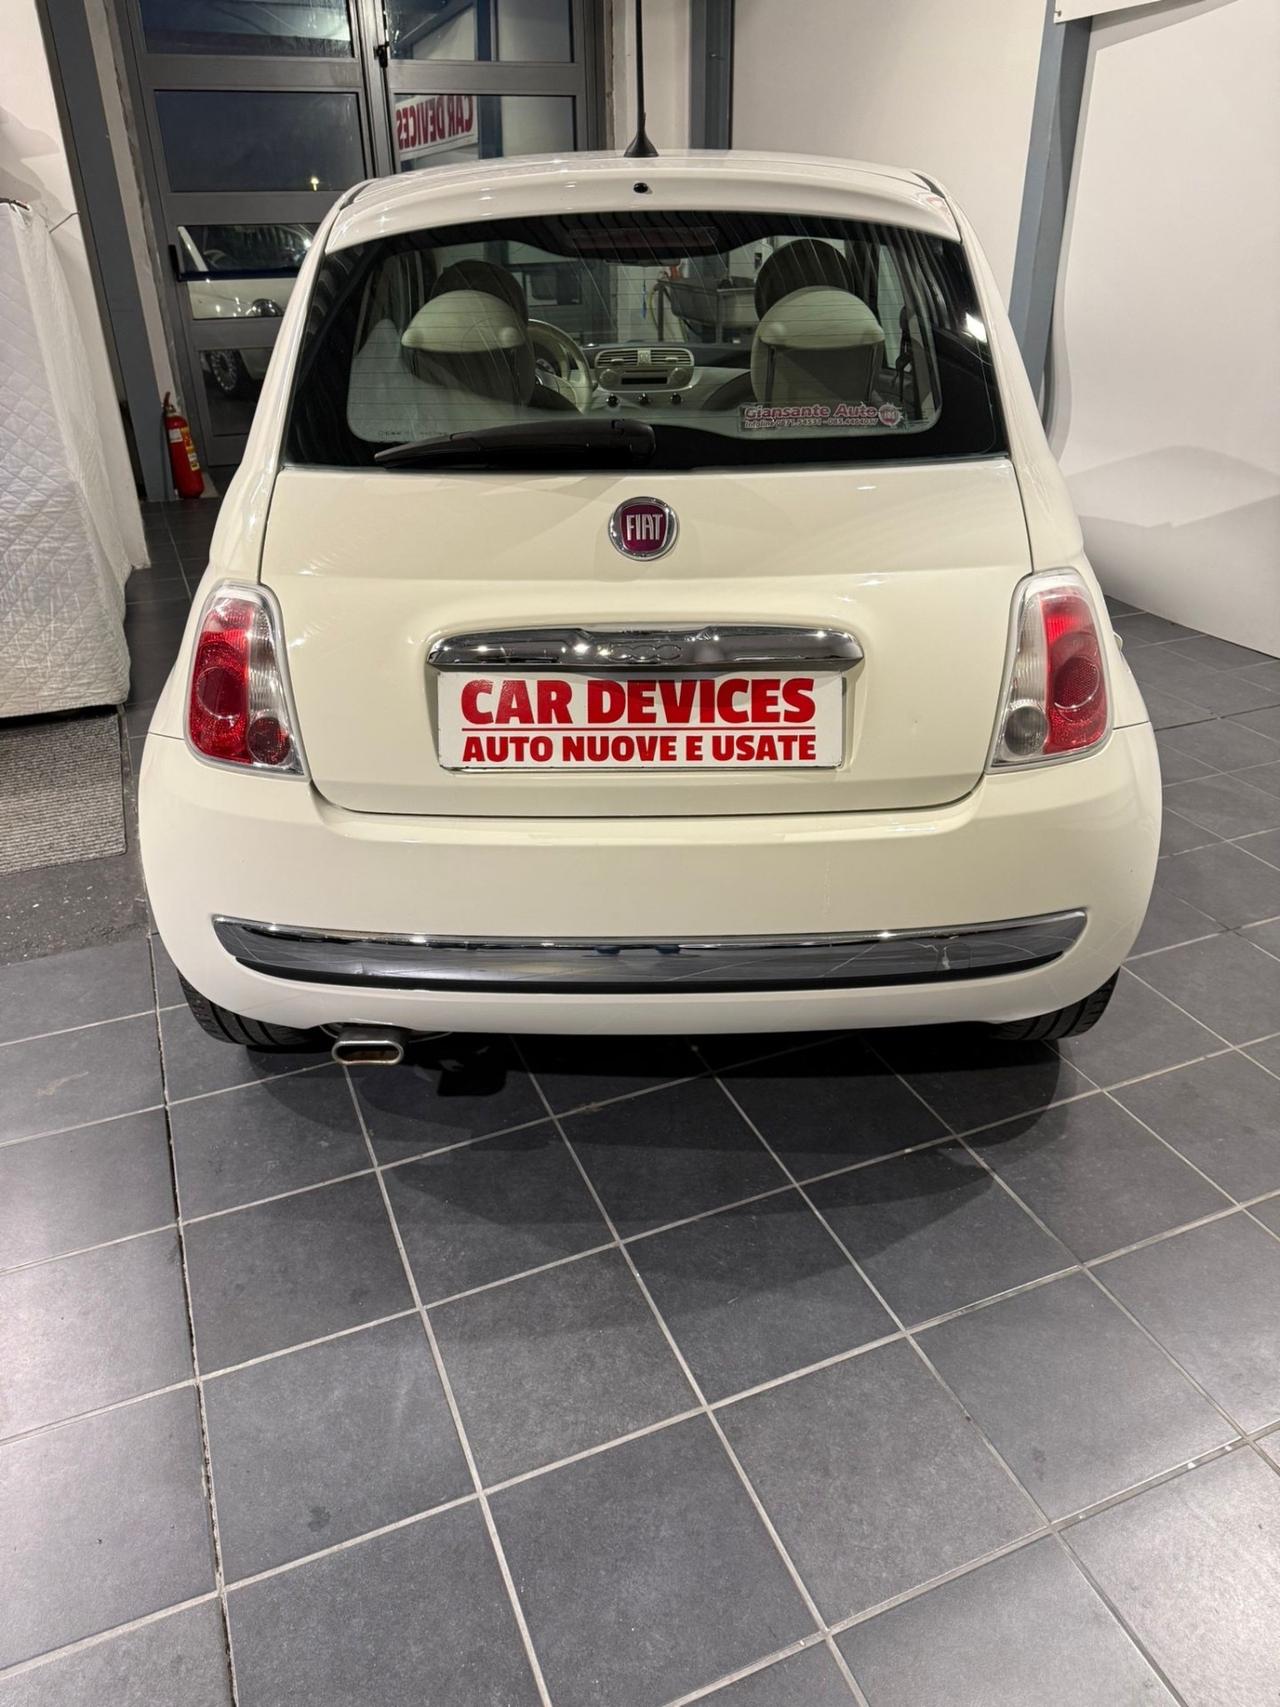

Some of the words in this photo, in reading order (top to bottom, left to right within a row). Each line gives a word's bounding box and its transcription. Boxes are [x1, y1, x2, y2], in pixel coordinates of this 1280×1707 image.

[745, 405, 831, 418] Giansante
[833, 403, 877, 417] Auto
[626, 513, 663, 541] FIAT
[461, 680, 573, 725] CAR
[587, 678, 816, 725] DEVICES
[462, 736, 554, 763] AUTO
[562, 735, 678, 762] NUOVE
[686, 735, 703, 762] E
[711, 734, 817, 762] USATE
